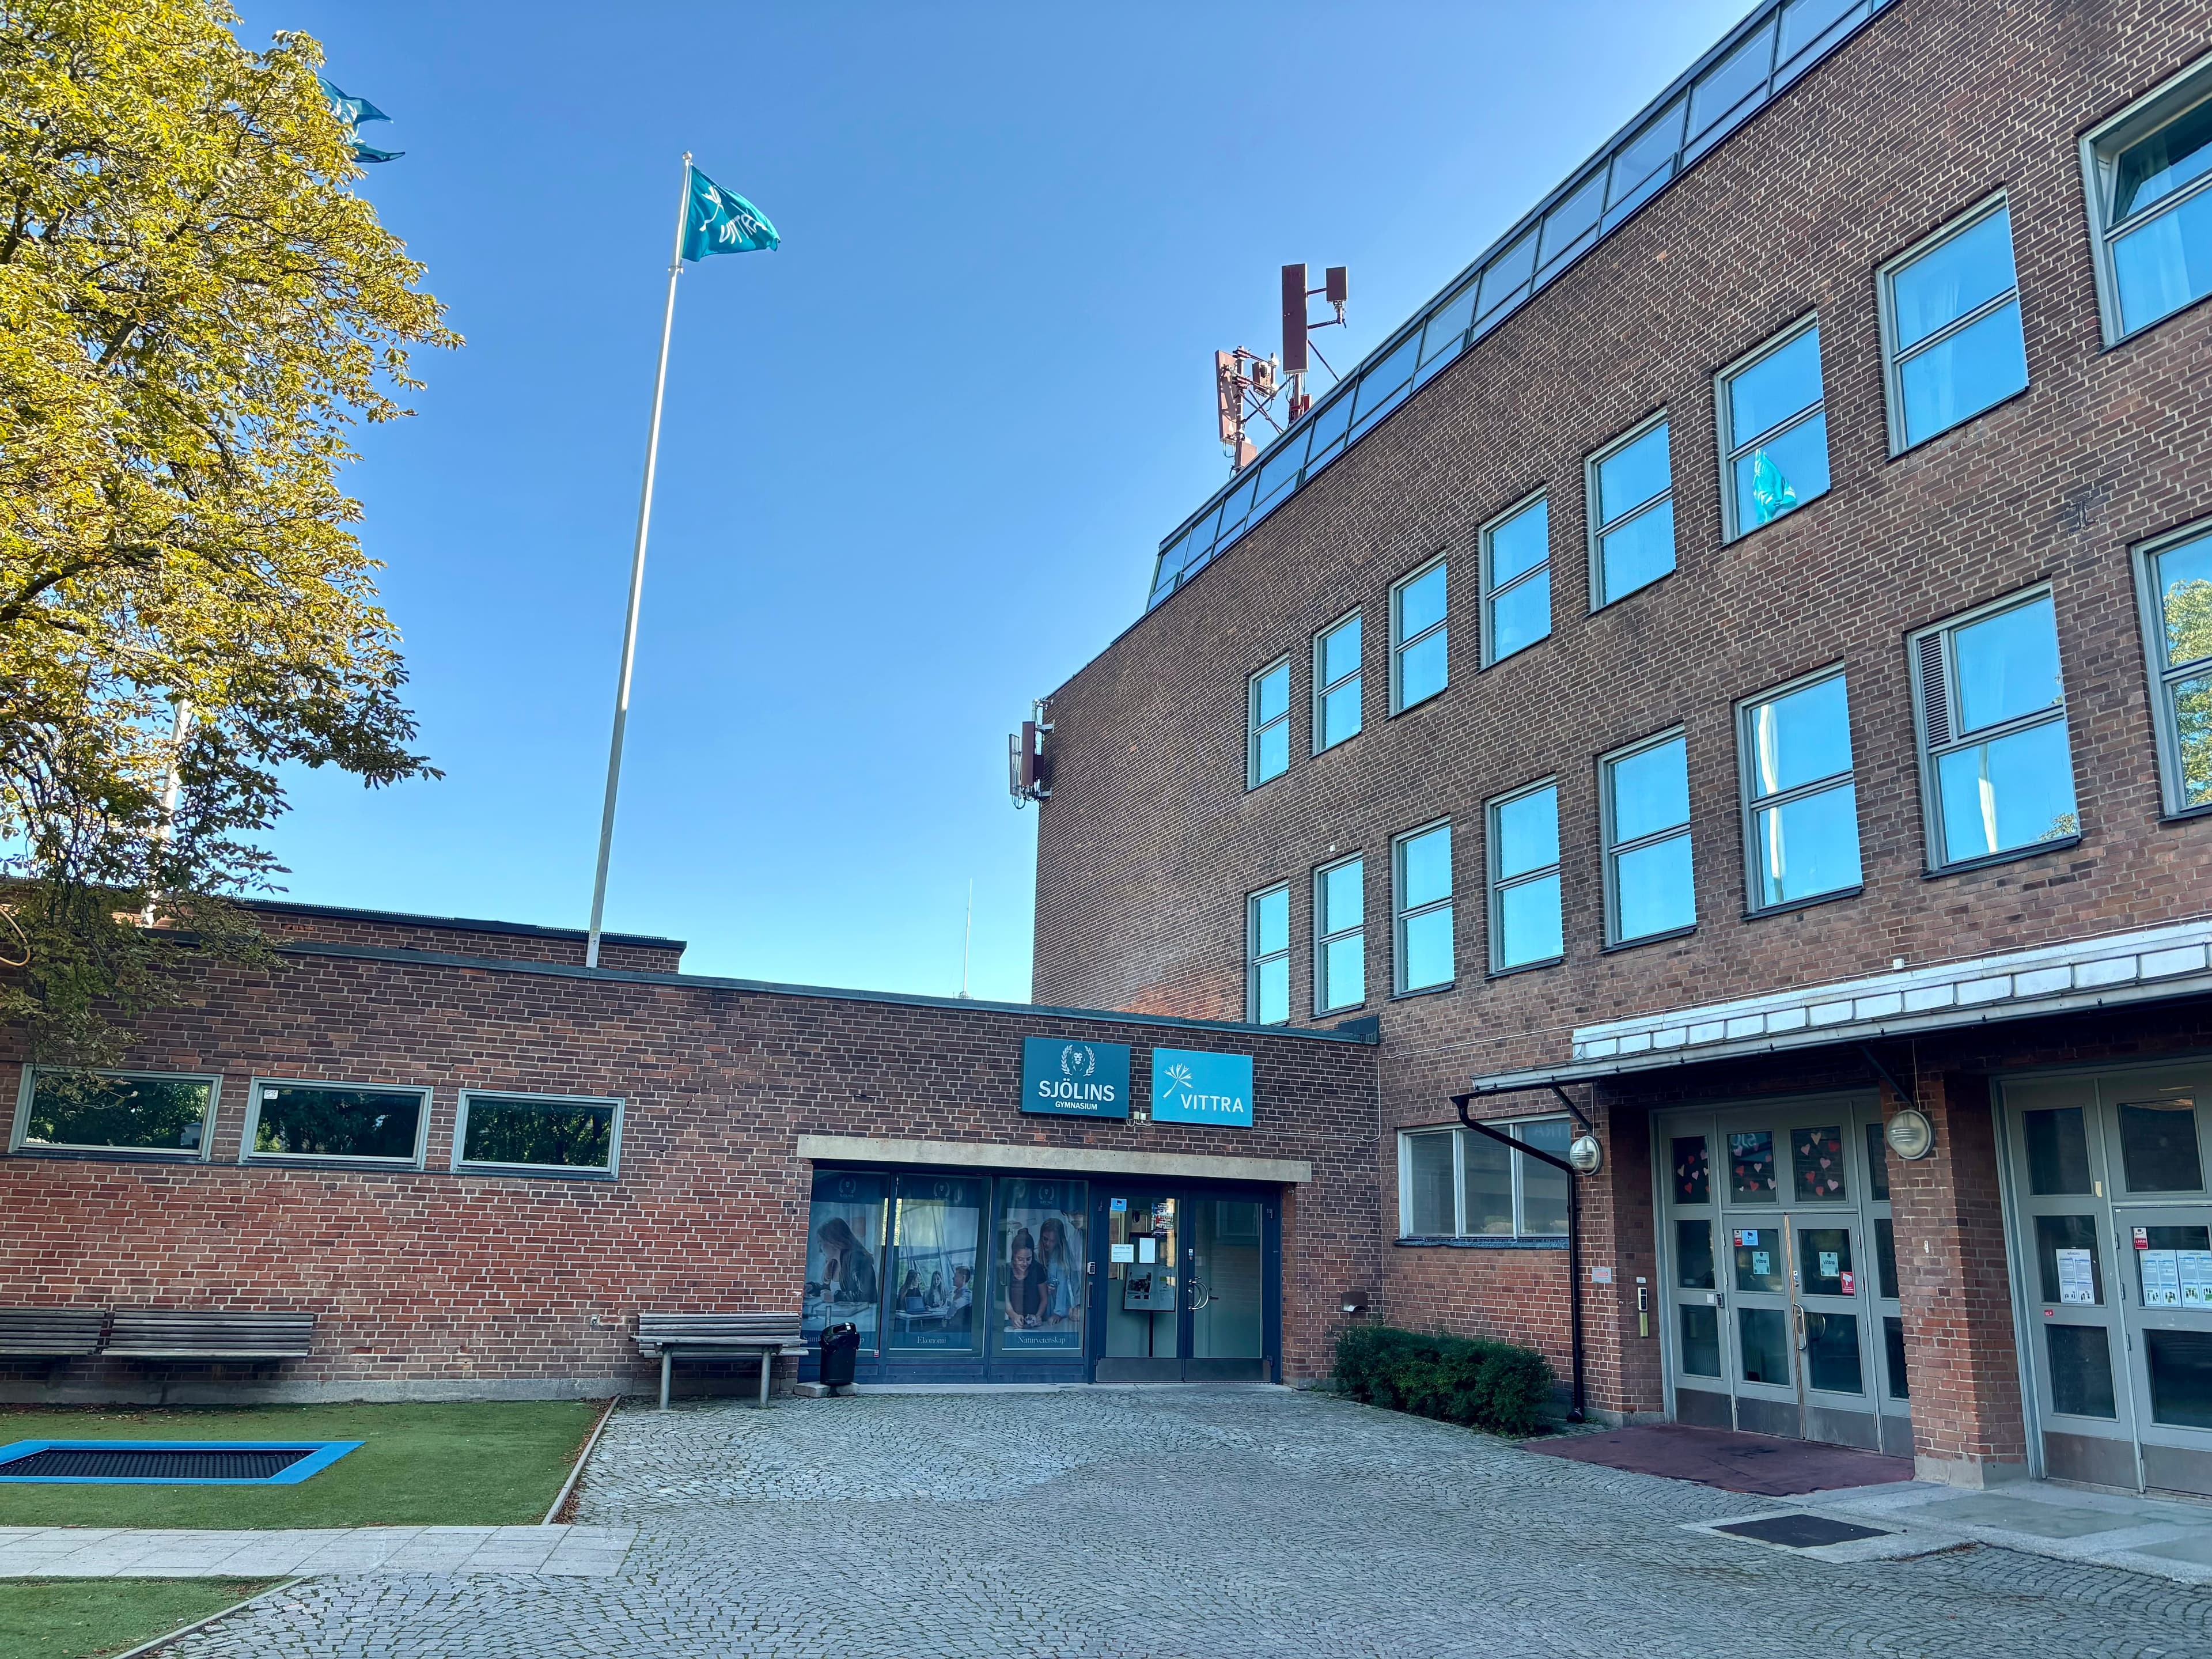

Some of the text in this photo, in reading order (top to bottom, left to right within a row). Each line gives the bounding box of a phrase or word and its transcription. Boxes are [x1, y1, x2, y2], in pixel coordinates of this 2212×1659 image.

[1038, 1078, 1115, 1103] SJÖLINS
[1055, 1101, 1098, 1111] GYMNASIUM
[1180, 1093, 1244, 1113] VITTRA
[916, 1335, 946, 1344] Ekonomi
[1018, 1335, 1066, 1345] Naturvetenskap
